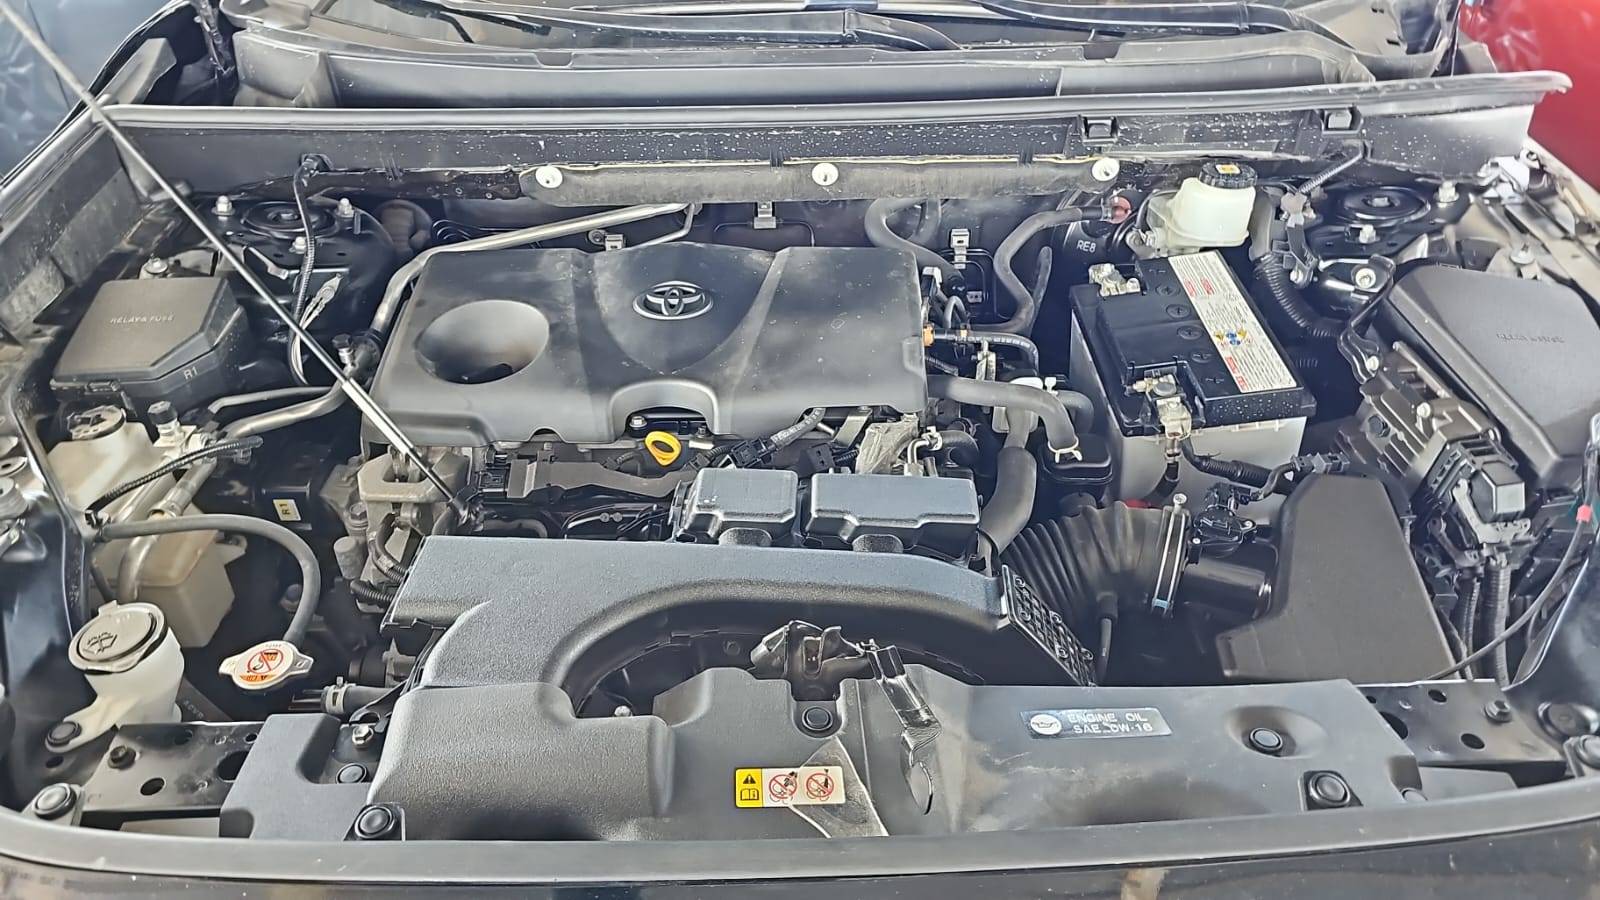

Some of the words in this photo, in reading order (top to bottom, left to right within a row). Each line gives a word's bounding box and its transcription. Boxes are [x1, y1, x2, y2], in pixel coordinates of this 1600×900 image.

[1076, 240, 1096, 253] RE8
[183, 366, 198, 380] R1
[1067, 712, 1118, 723] ENGINE
[1125, 712, 1149, 722] OIL
[1073, 725, 1102, 734] SAE
